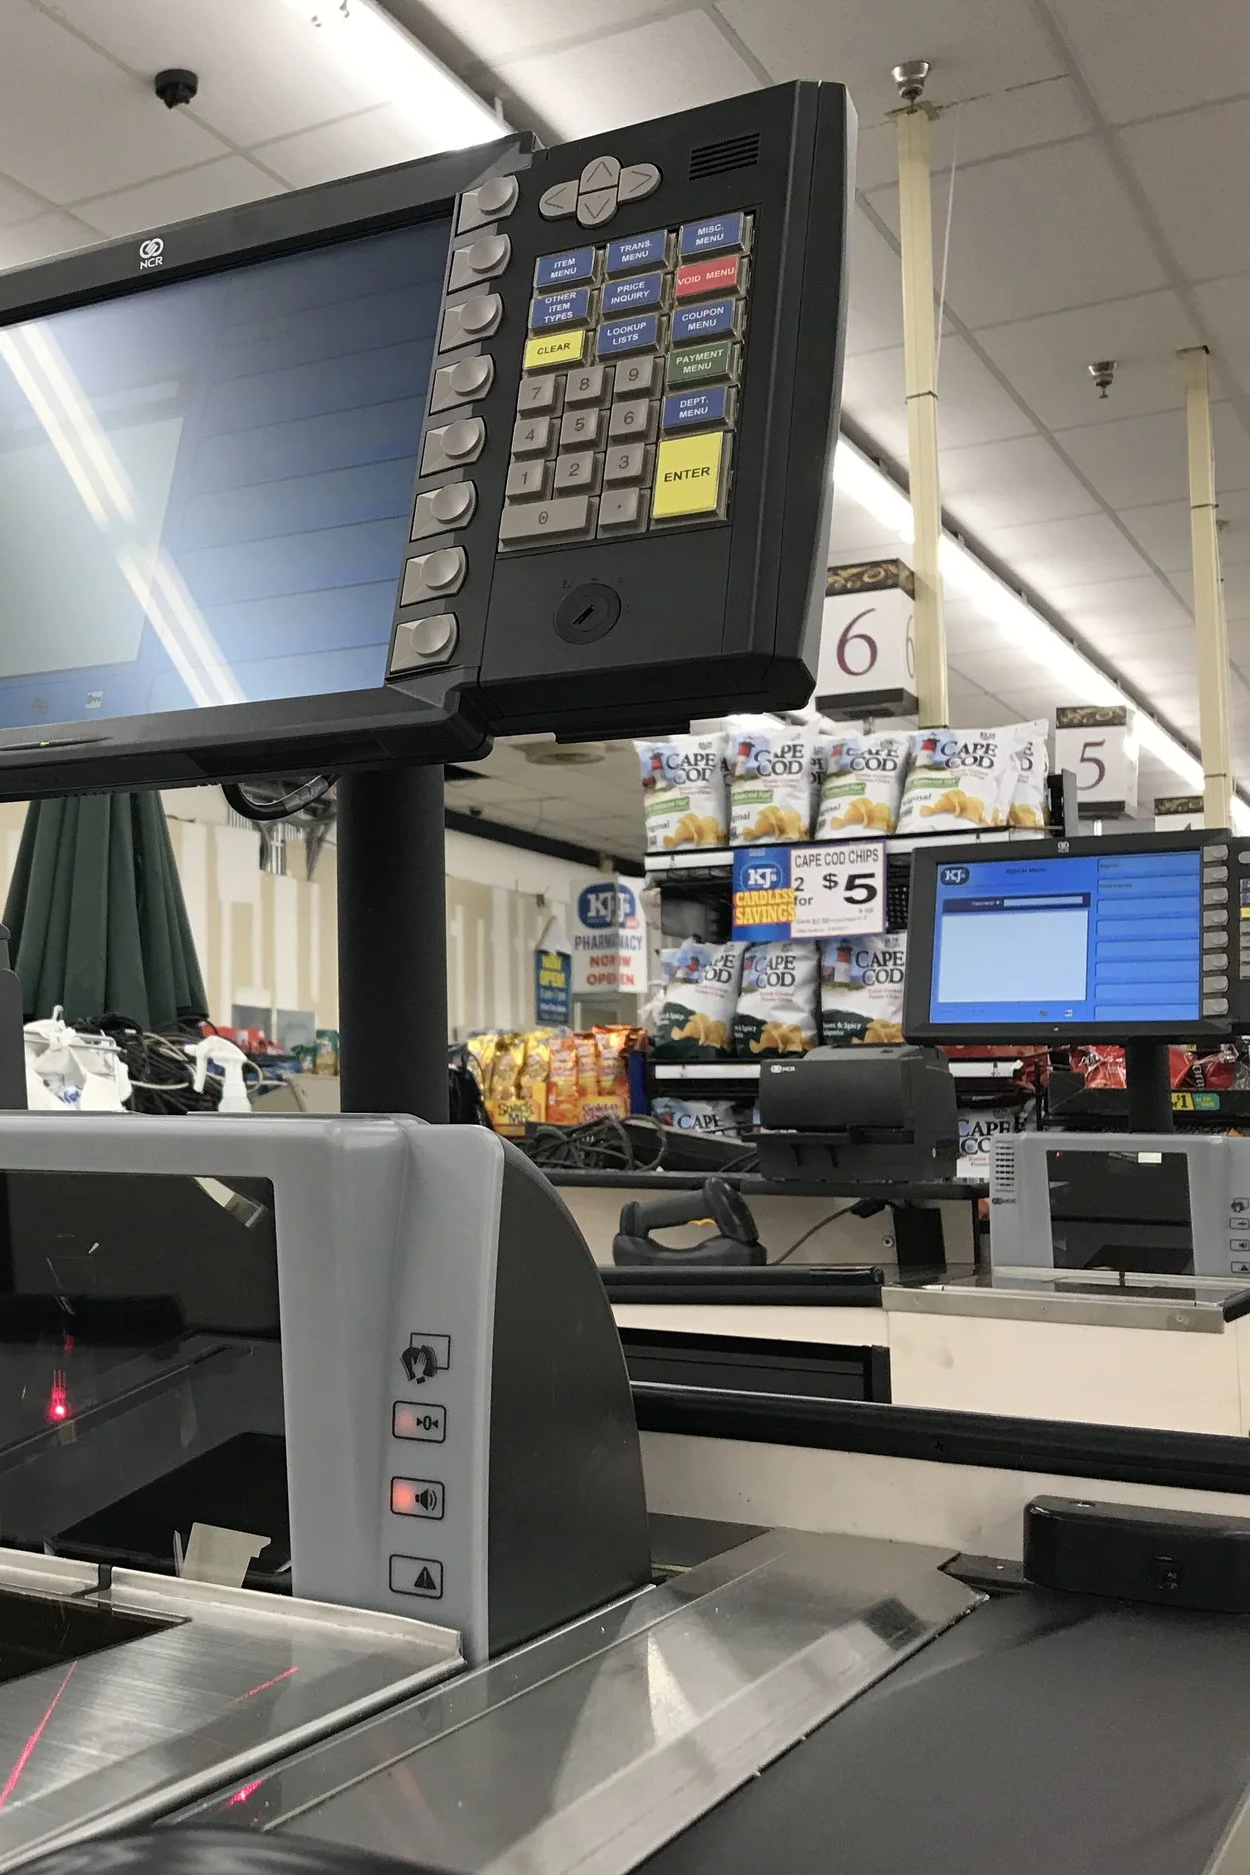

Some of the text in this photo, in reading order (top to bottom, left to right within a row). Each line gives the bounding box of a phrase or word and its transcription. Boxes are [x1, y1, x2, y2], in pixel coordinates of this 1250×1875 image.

[696, 222, 725, 237] MISC.
[619, 239, 653, 254] TRANS.
[695, 232, 724, 246] MENU
[139, 256, 163, 270] NCR
[553, 257, 576, 269] ITEM
[621, 250, 649, 263] MENU
[550, 266, 577, 279] MENU
[677, 266, 735, 287] VOID MENU
[616, 280, 645, 294] PRICE
[544, 291, 577, 304] OTHER
[610, 289, 650, 305] INQUIRY
[548, 301, 571, 313] ITEM
[681, 306, 724, 321] COUPON
[543, 311, 574, 324] TYPES
[687, 318, 717, 331] MENU
[606, 321, 647, 337] LOOKUP
[612, 332, 639, 345] LISTS
[536, 342, 571, 356] CLEAR
[676, 348, 724, 364] PAYMENT
[628, 367, 639, 382] 9
[682, 360, 712, 374] MENU
[578, 376, 590, 391] 8
[531, 386, 543, 401] 7
[679, 395, 709, 409] DEPT.
[623, 411, 634, 424] 6
[678, 405, 709, 419] MENU
[574, 417, 586, 432] 5
[524, 428, 535, 441] 4
[569, 462, 580, 477] 2
[618, 455, 630, 470] 3
[664, 466, 711, 482] ENTER
[538, 511, 549, 525] 0
[836, 607, 878, 677] 6
[754, 744, 804, 763] CAPE
[940, 741, 998, 757] CAPE
[666, 753, 716, 770] CAPE
[756, 759, 803, 777] COD
[850, 756, 898, 771] COD
[945, 755, 994, 770] COD
[1077, 738, 1107, 790] 5
[674, 767, 714, 785] COD
[794, 849, 879, 868] CAPE COD CHIPS
[794, 877, 805, 892] 2
[736, 888, 795, 906] CARDLESS
[794, 895, 814, 907] for
[735, 904, 796, 925] SAVINGS
[754, 955, 796, 972] CAPE
[855, 950, 904, 968] CAPE
[755, 971, 796, 988] COD
[862, 968, 904, 986] COD
[961, 1137, 991, 1155] CO
